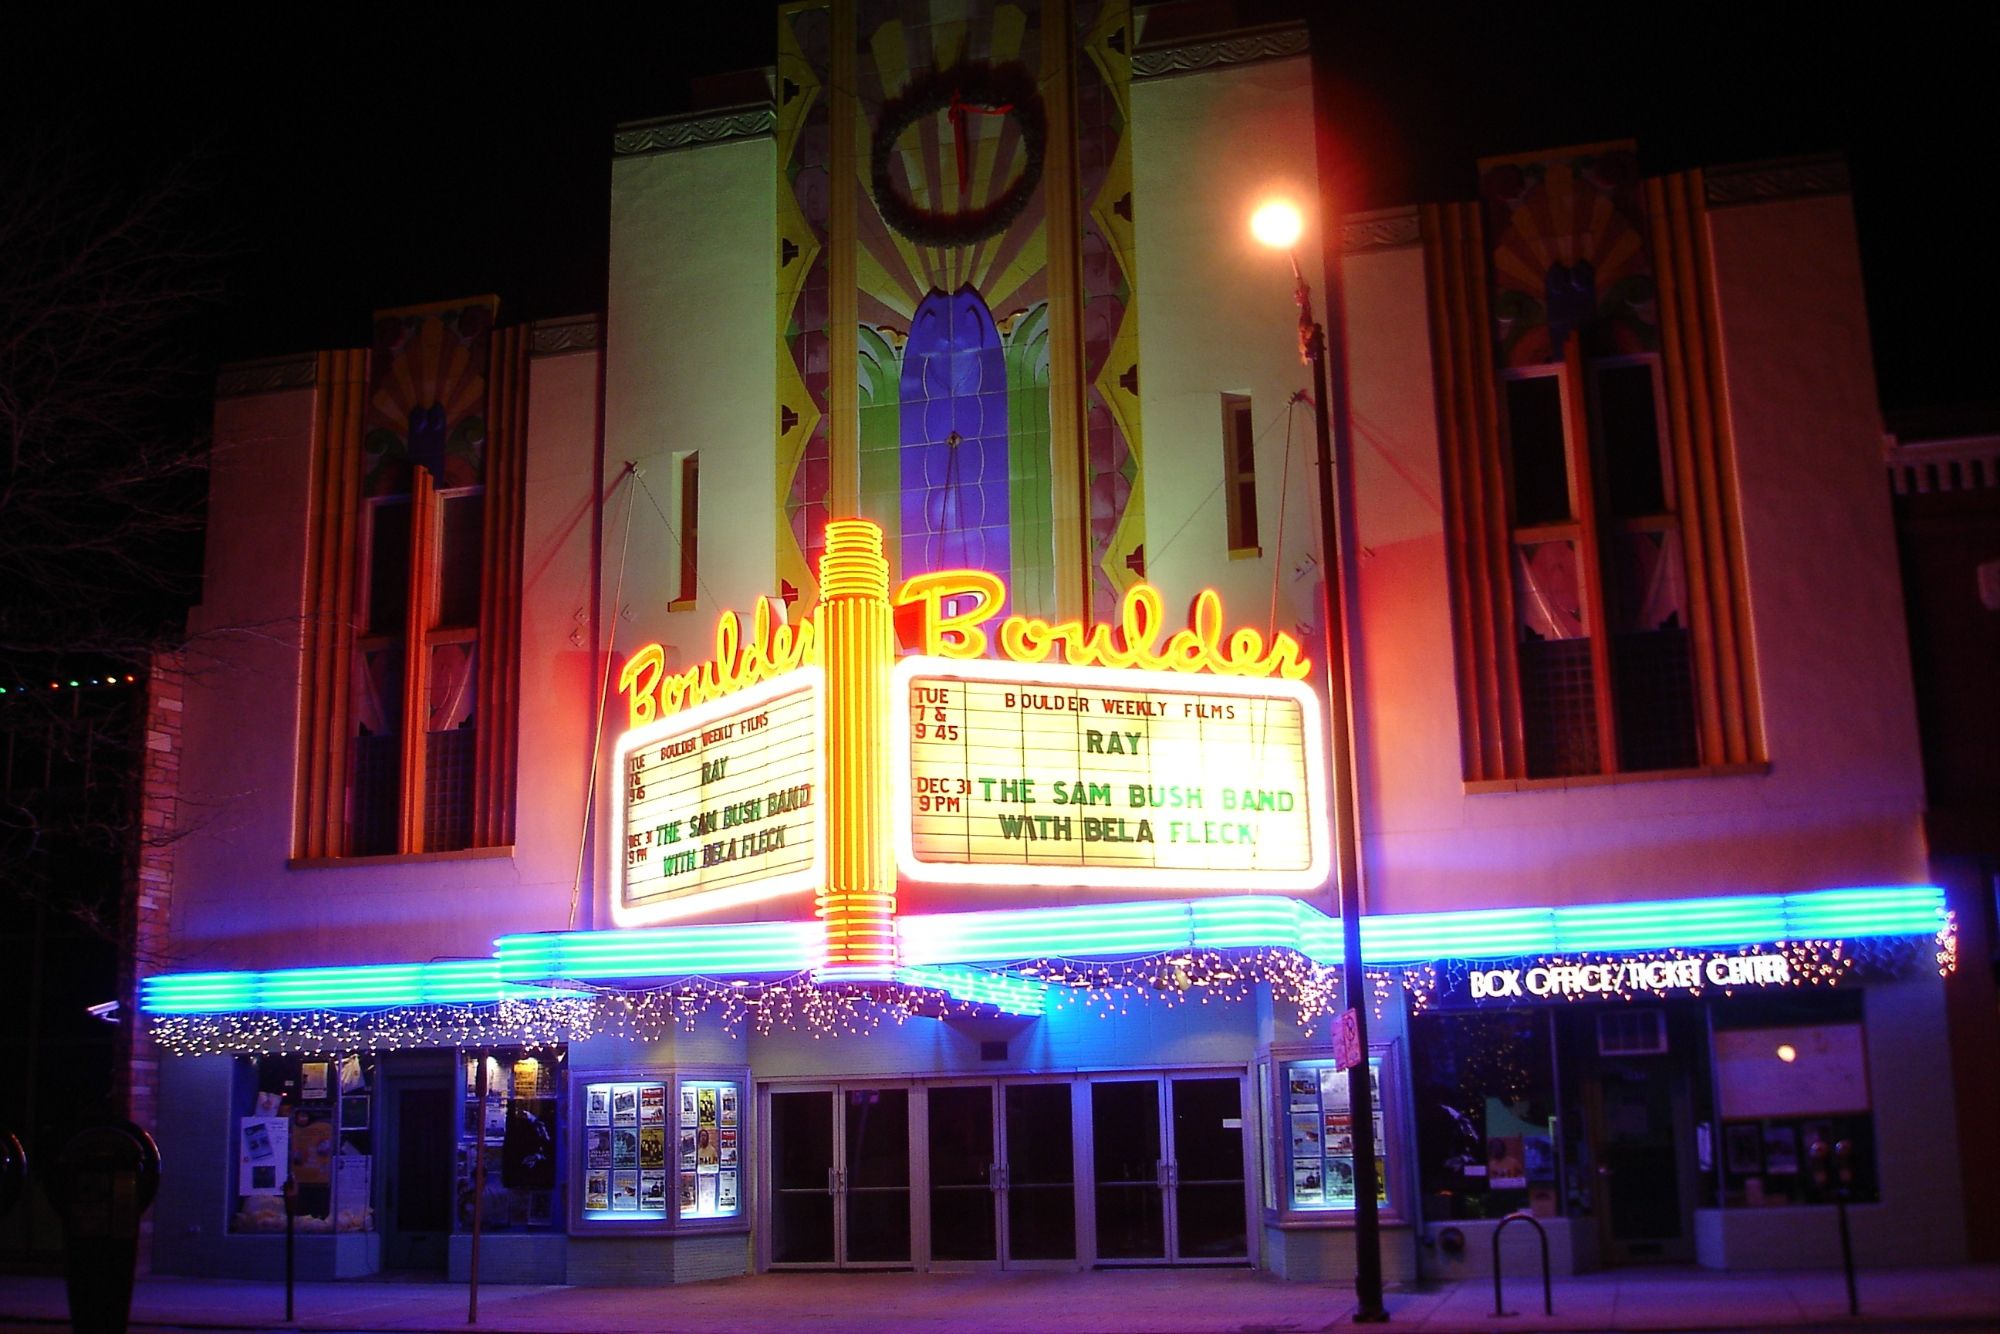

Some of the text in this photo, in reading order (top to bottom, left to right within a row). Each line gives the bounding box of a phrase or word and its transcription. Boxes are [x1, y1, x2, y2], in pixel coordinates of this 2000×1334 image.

[896, 569, 1312, 681] Boulder
[618, 595, 816, 730] Boulder
[914, 687, 949, 704] TUE
[1004, 693, 1236, 720] BOULDER WEEKLY FILMS
[914, 705, 947, 722] 7 &
[660, 711, 769, 761] BOULDER WEEKLY FILMS
[915, 723, 959, 741] 9 45
[1086, 729, 1142, 755] RAY
[630, 753, 646, 772] TUE
[702, 755, 729, 785] RAY
[916, 777, 972, 795] DEC 31
[978, 777, 1295, 813] THE SAM BUSH BAND
[656, 783, 812, 847] THE SAM BUSH BAND
[918, 795, 960, 813] 9 PM
[998, 813, 1256, 846] WITH BELA FLECK
[663, 824, 788, 877] WITH BELA FLECK
[1469, 953, 1792, 999] BOX OFFICE/TICKET CENTER
